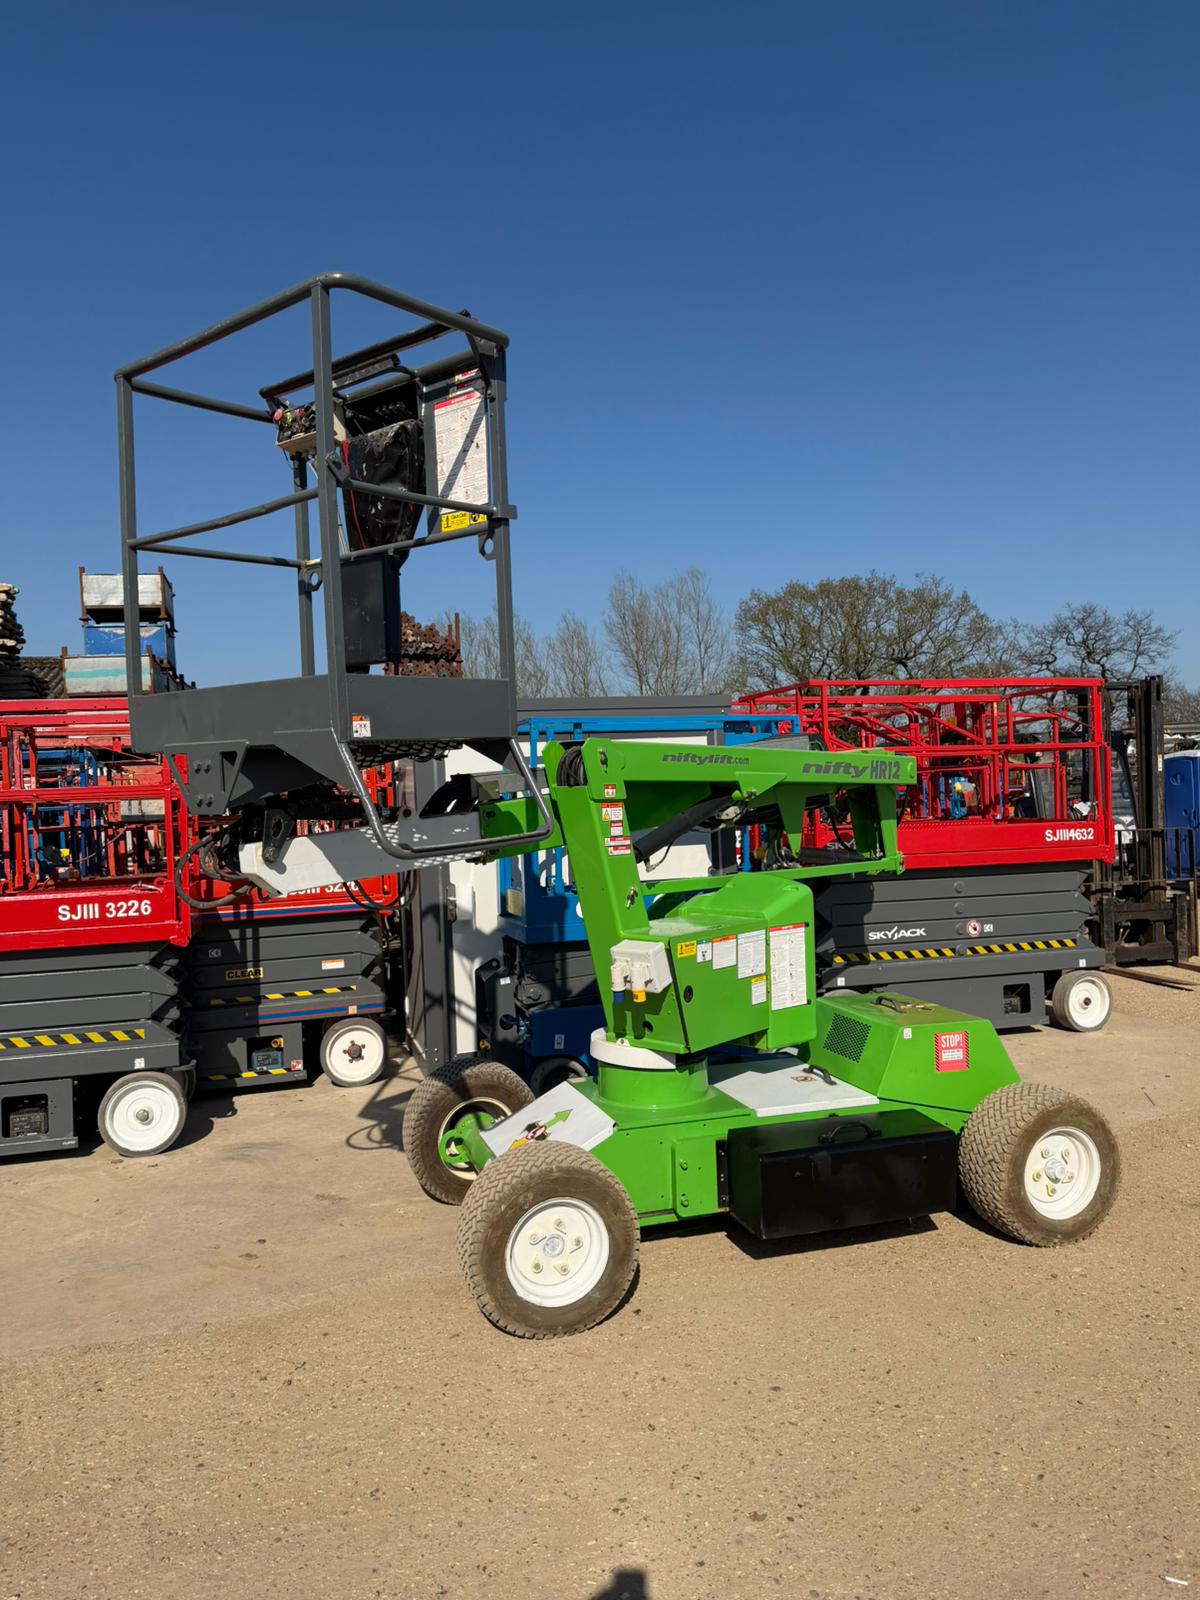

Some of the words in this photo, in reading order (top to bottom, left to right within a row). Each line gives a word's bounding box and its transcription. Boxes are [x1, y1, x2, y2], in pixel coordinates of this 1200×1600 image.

[662, 752, 750, 765] niftylift.com
[802, 761, 869, 778] nifty
[865, 759, 899, 780] HR12
[58, 903, 100, 921] SJIII
[105, 899, 152, 918] 3226
[868, 926, 927, 941] SKYJACK
[227, 969, 262, 979] CLEAR
[941, 1034, 963, 1048] STOP!
